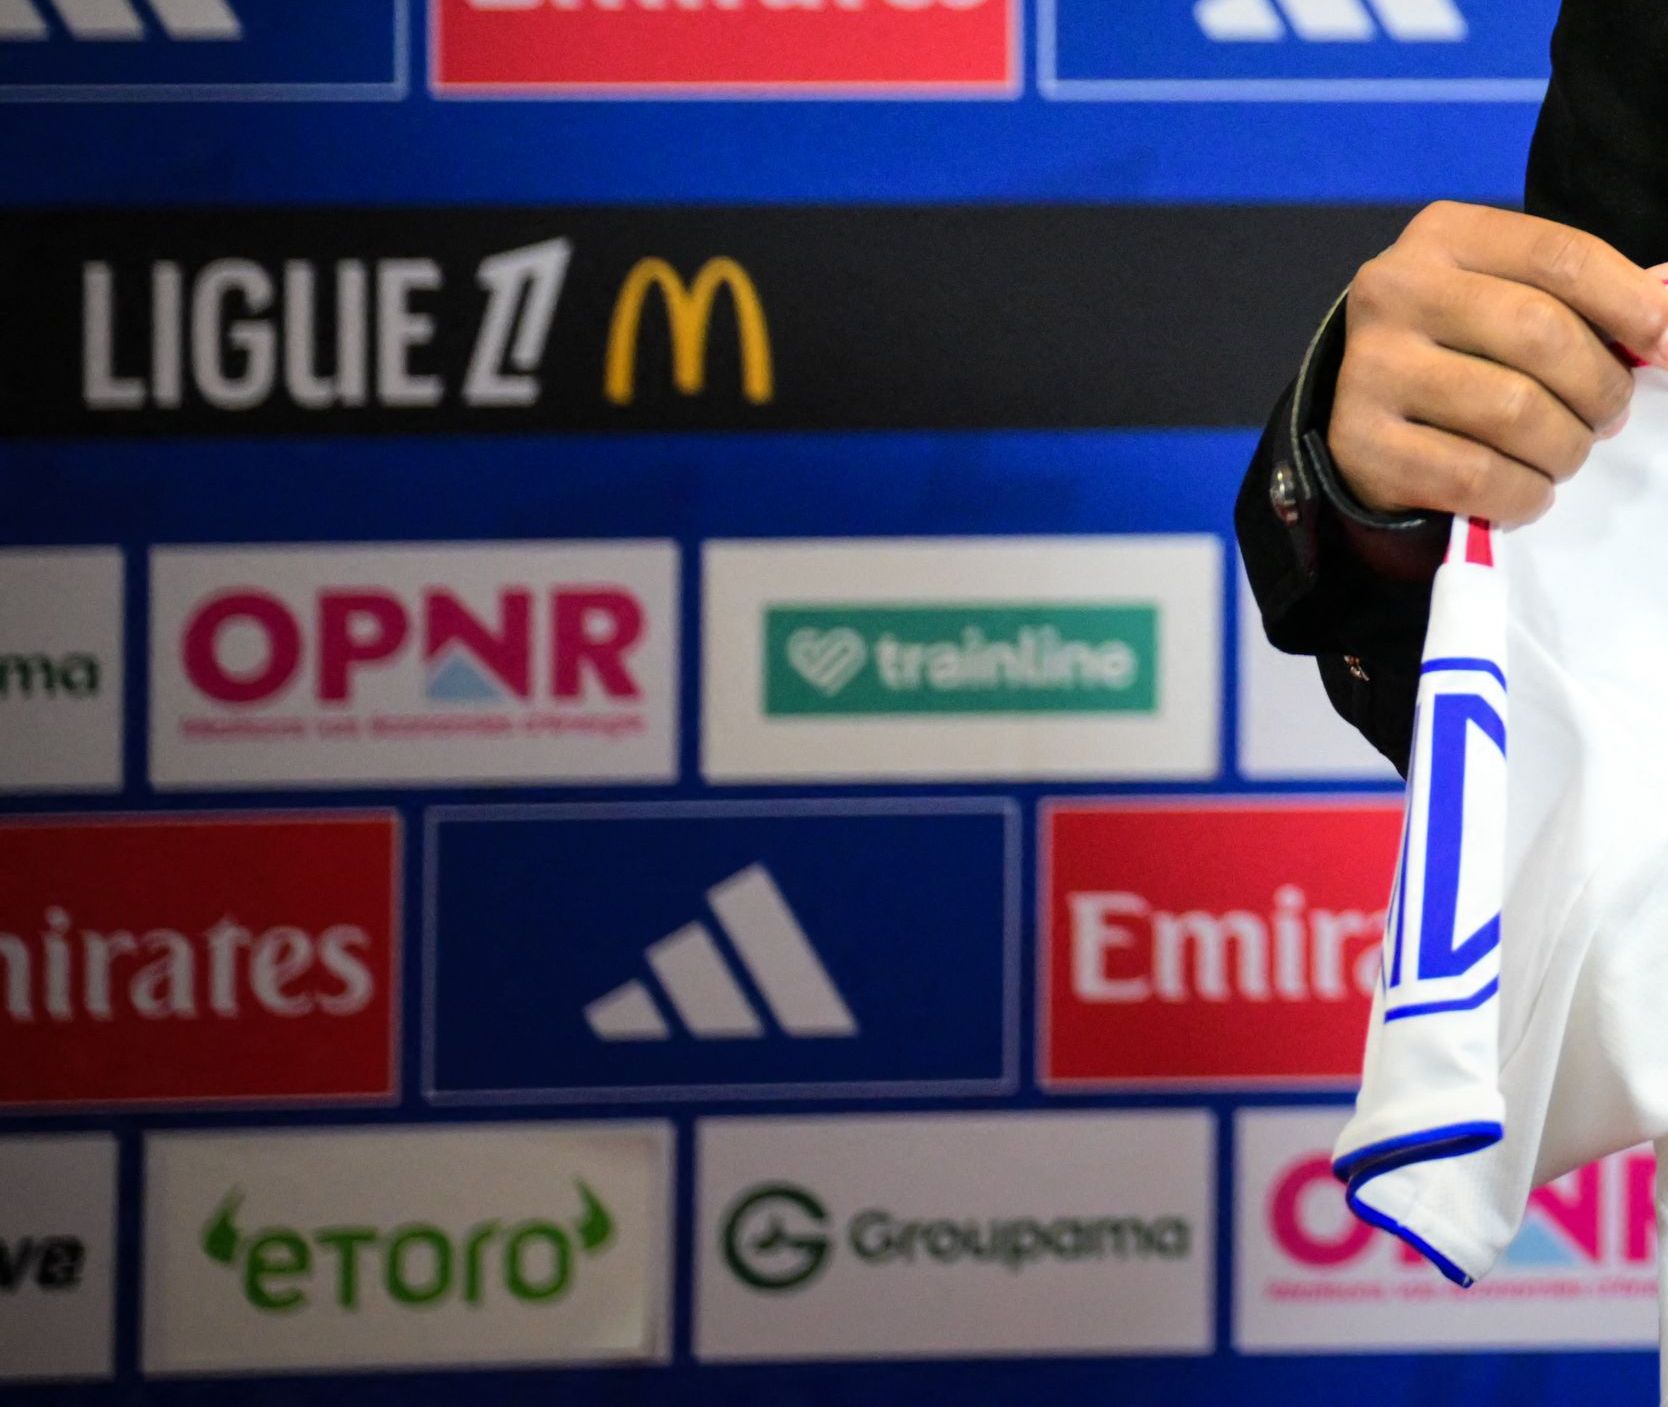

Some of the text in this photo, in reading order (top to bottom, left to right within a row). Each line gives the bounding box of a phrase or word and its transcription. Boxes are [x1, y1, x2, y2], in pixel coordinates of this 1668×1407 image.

[84, 258, 443, 408] LIGUE
[180, 585, 645, 706] OPNR
[876, 626, 1138, 691] trainline
[0, 909, 374, 1017] irates
[852, 1208, 1190, 1272] Groupama
